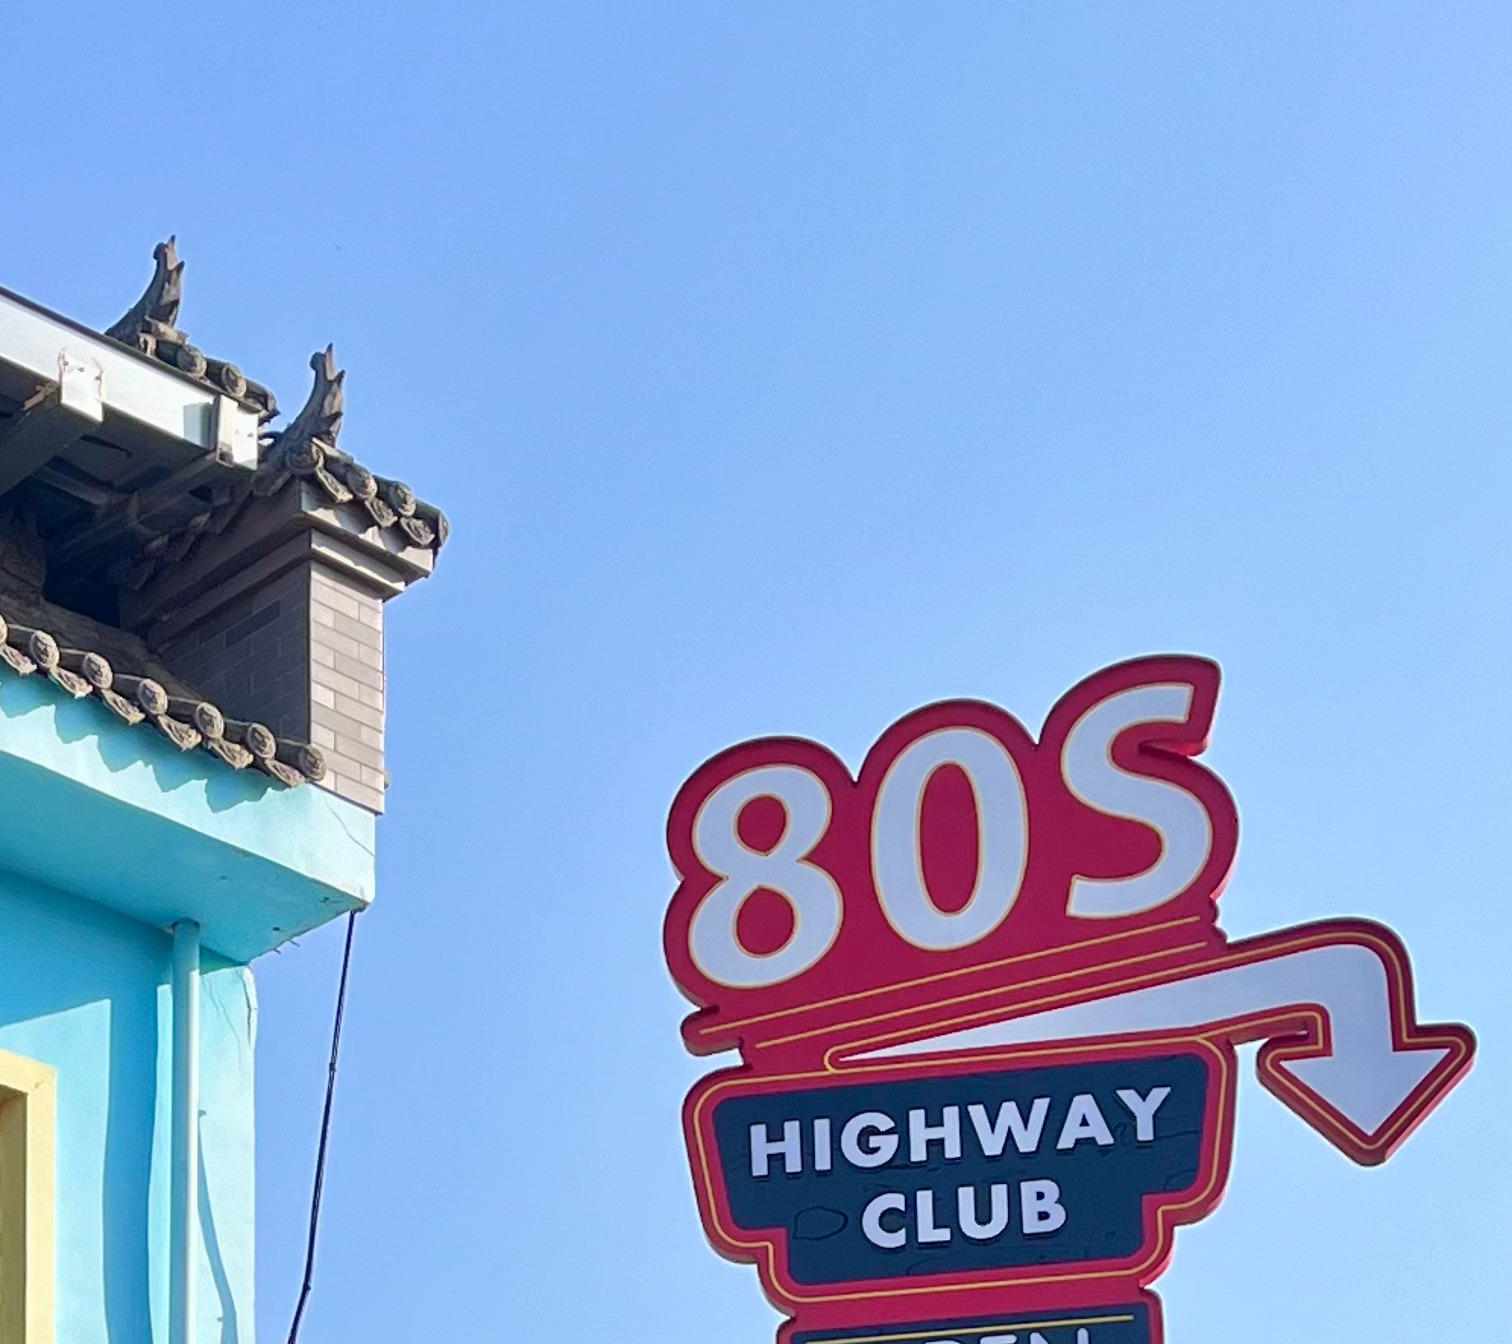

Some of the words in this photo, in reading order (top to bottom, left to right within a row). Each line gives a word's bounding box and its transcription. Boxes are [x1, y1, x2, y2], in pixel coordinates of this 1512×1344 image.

[689, 682, 1214, 989] 80S
[749, 1085, 1172, 1178] HIGHWAY
[861, 1179, 1068, 1249] CLUB
